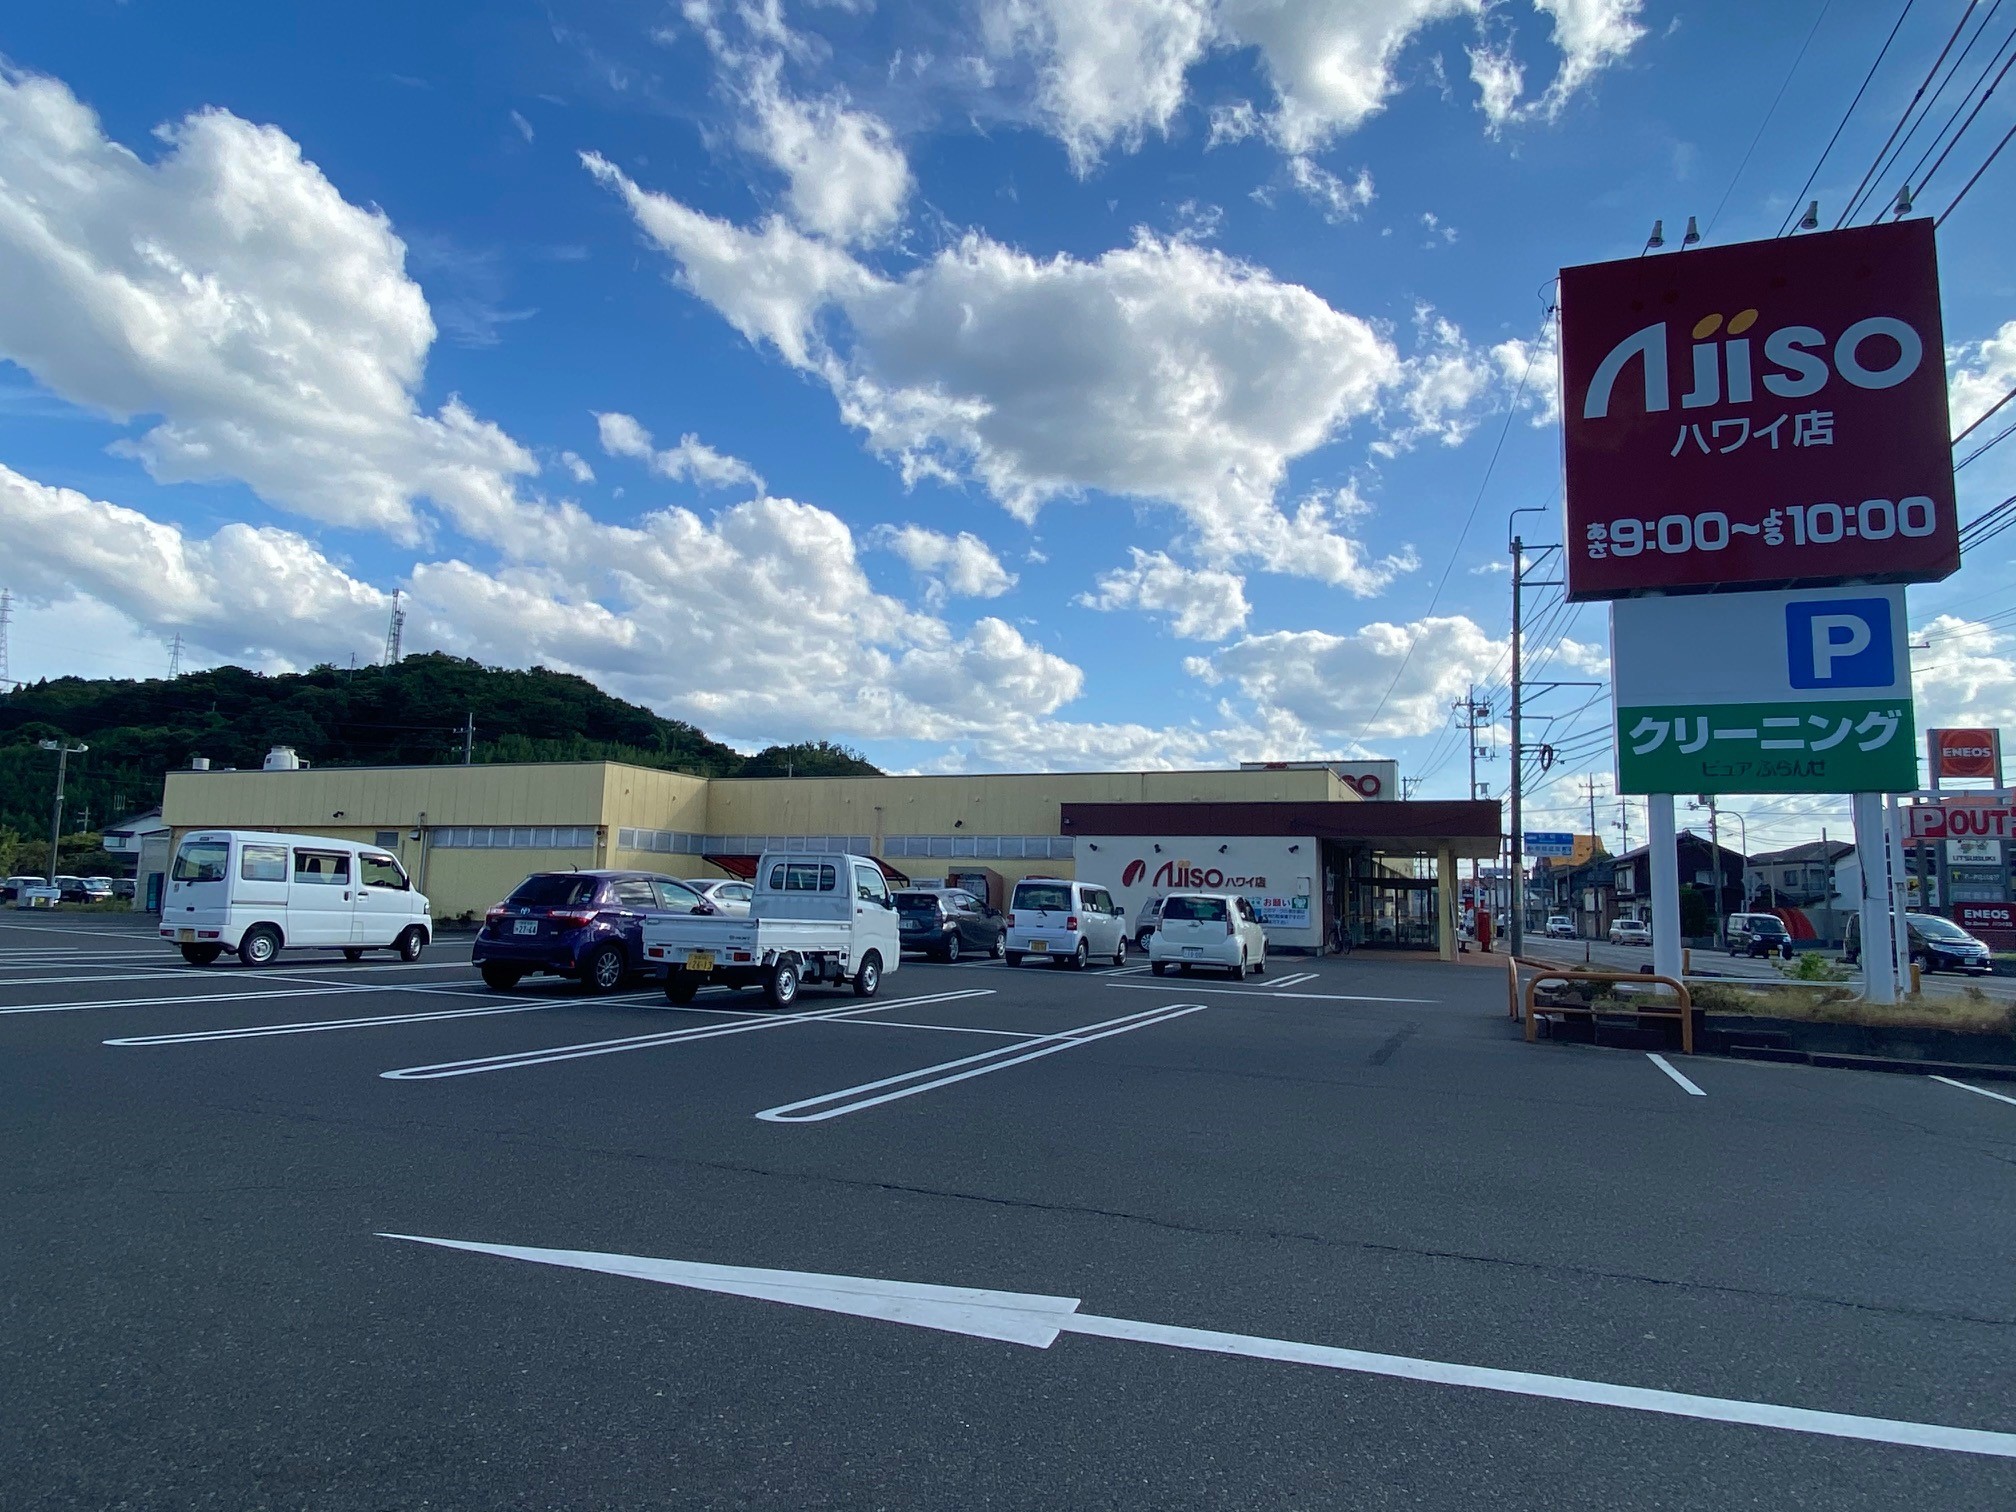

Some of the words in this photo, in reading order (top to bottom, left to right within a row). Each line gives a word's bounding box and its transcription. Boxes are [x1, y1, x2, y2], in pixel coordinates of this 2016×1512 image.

[1583, 308, 1923, 419] Ajiso
[1669, 408, 1834, 458] ハワイ店
[1810, 614, 1871, 679] P
[1629, 709, 1903, 756] クリーニング
[1942, 747, 1991, 758] ENEOS
[1948, 809, 2009, 836] OUT
[1152, 860, 1224, 889] Ajiso
[1225, 876, 1267, 888] ハワイ店
[1963, 909, 2010, 920] ENEOS
